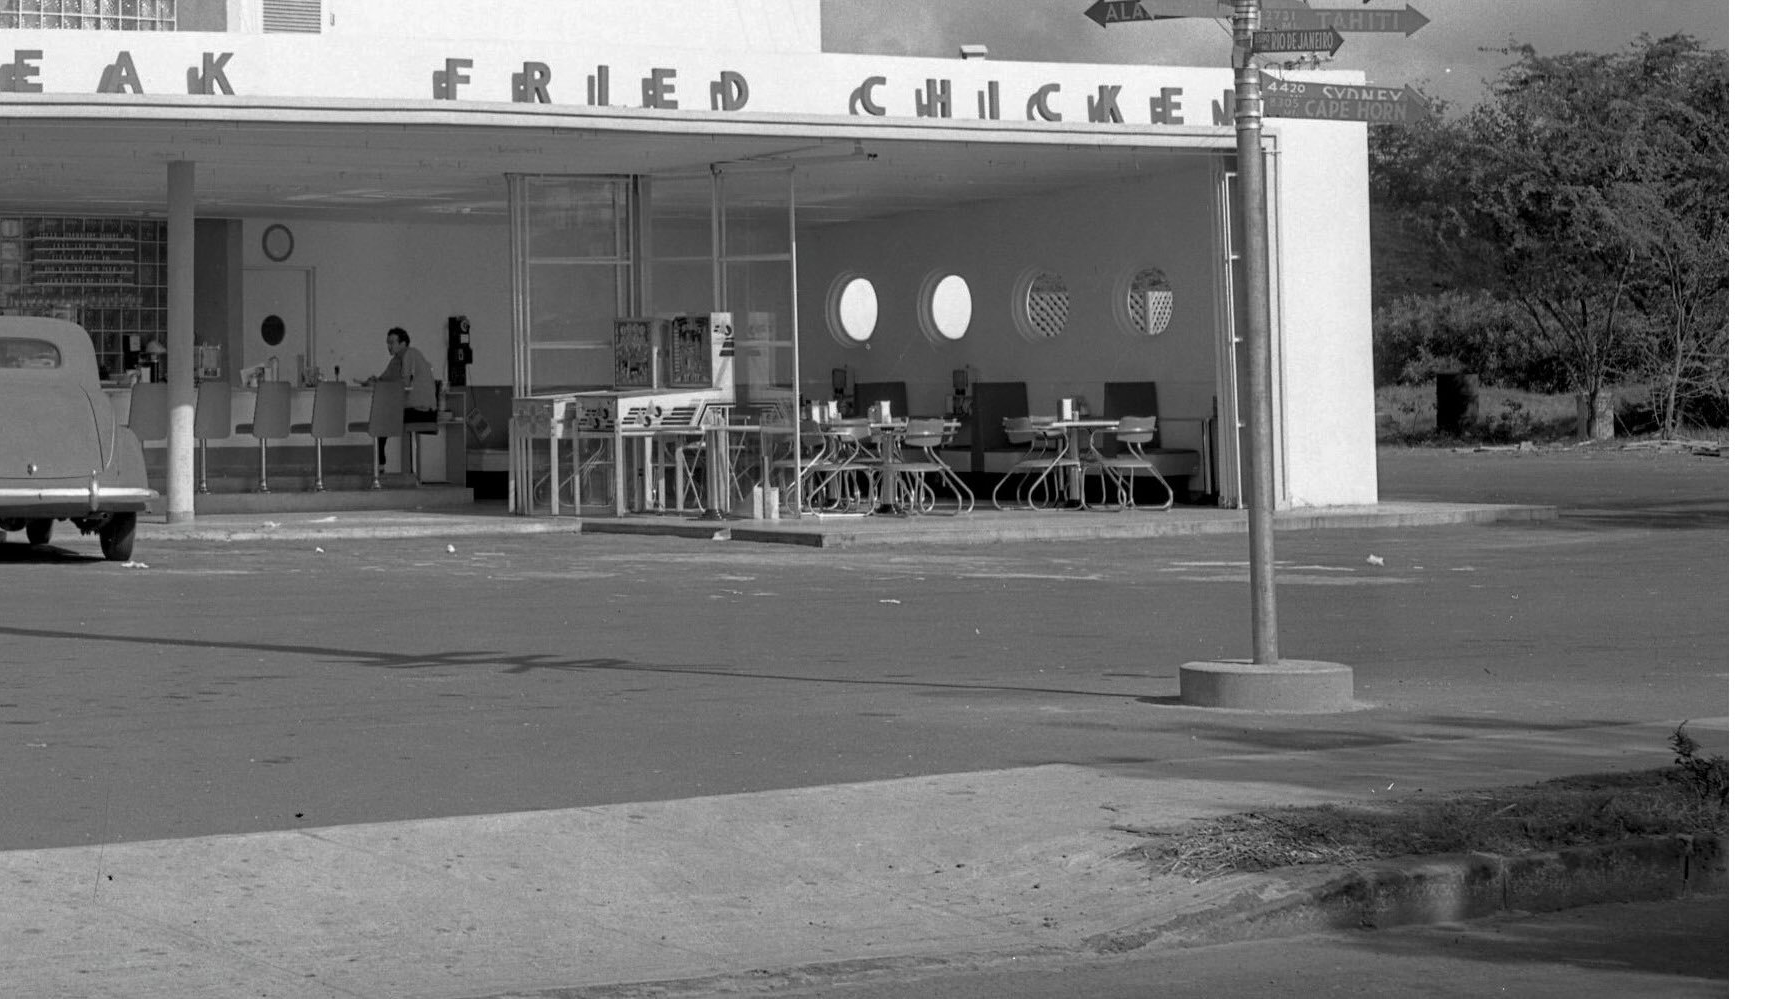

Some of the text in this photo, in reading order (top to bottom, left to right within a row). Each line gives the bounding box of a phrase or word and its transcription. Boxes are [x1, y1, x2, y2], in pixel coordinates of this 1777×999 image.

[1271, 32, 1286, 50] RIO
[1298, 31, 1334, 50] JANEIRO
[433, 57, 750, 112] FRIED
[1267, 81, 1306, 94] 4420
[1305, 101, 1351, 119] CAPE
[1357, 101, 1407, 121] HORN
